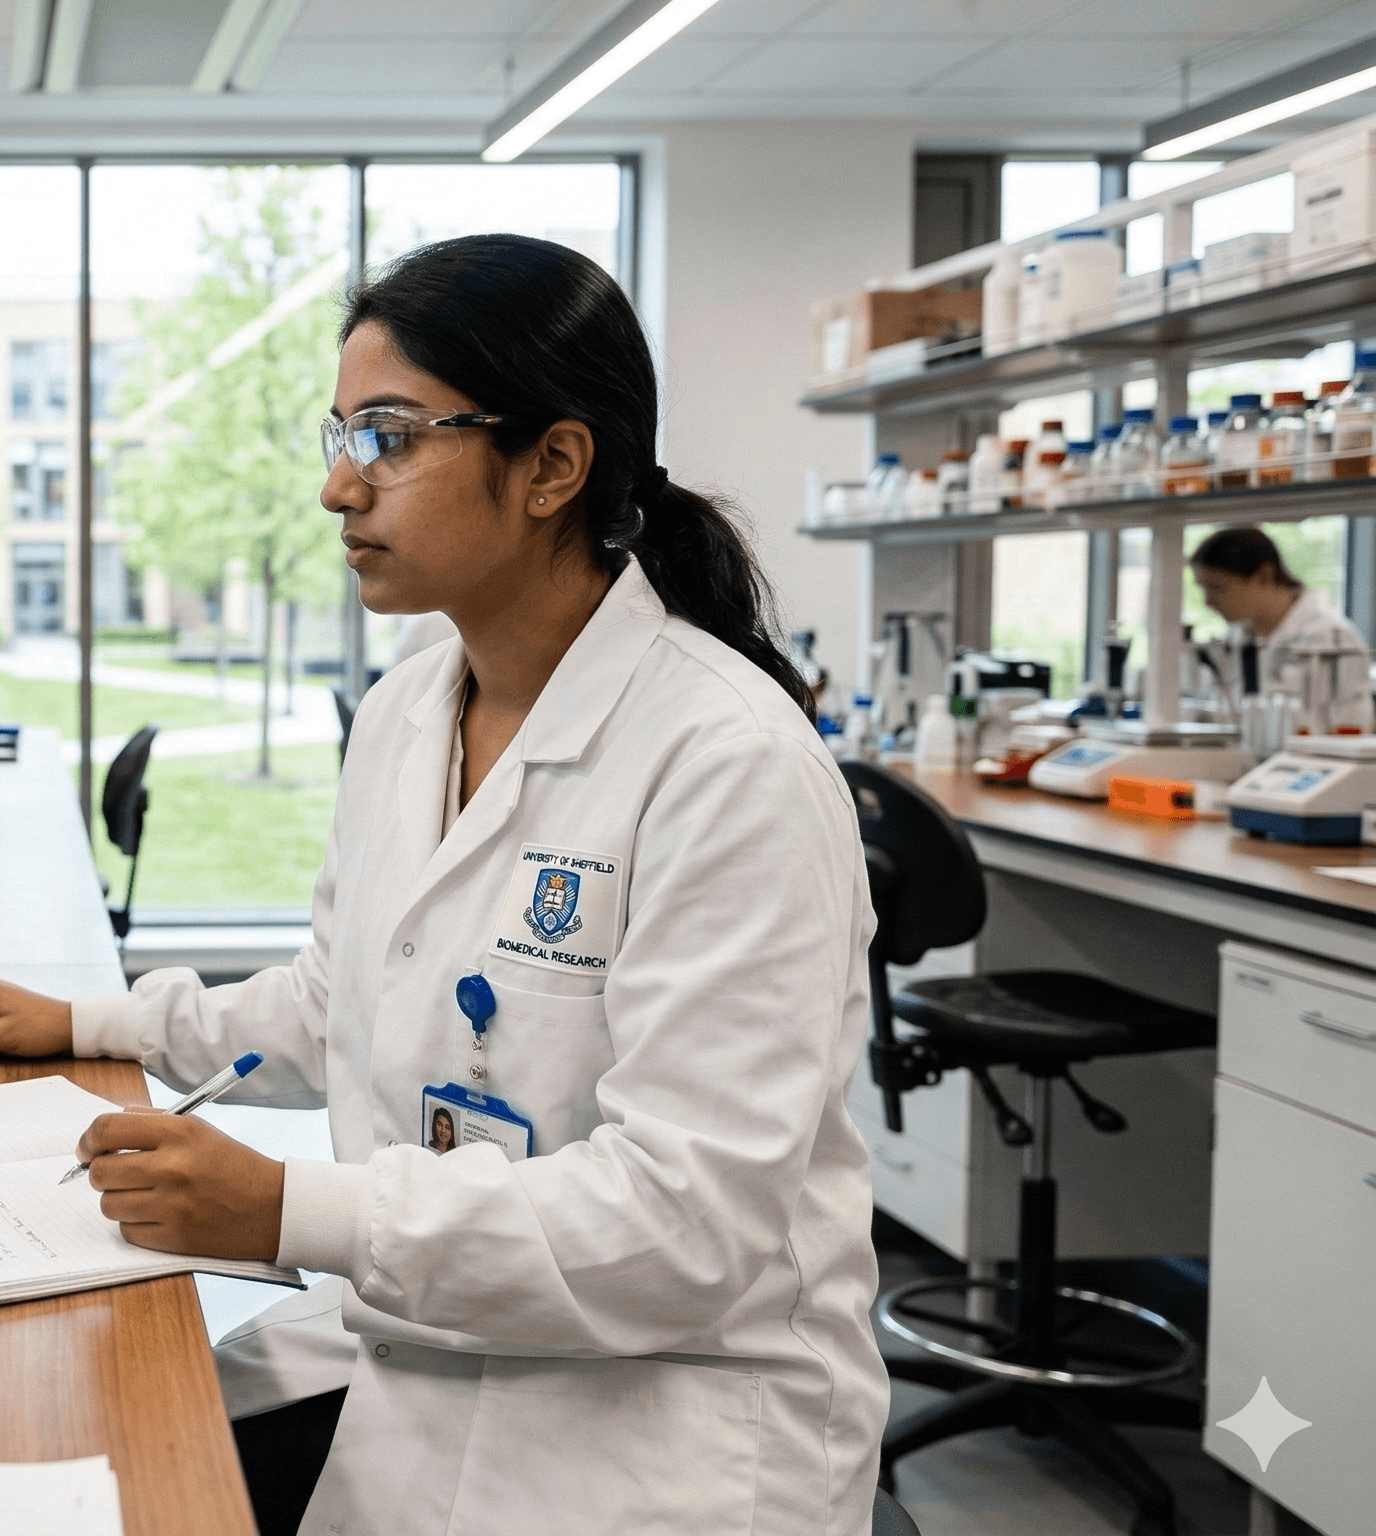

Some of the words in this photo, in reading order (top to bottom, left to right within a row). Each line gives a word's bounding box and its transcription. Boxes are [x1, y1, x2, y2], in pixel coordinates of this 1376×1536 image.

[559, 856, 570, 867] OF
[496, 938, 549, 960] BIOMEDICAL
[551, 950, 607, 969] RESEARCH
